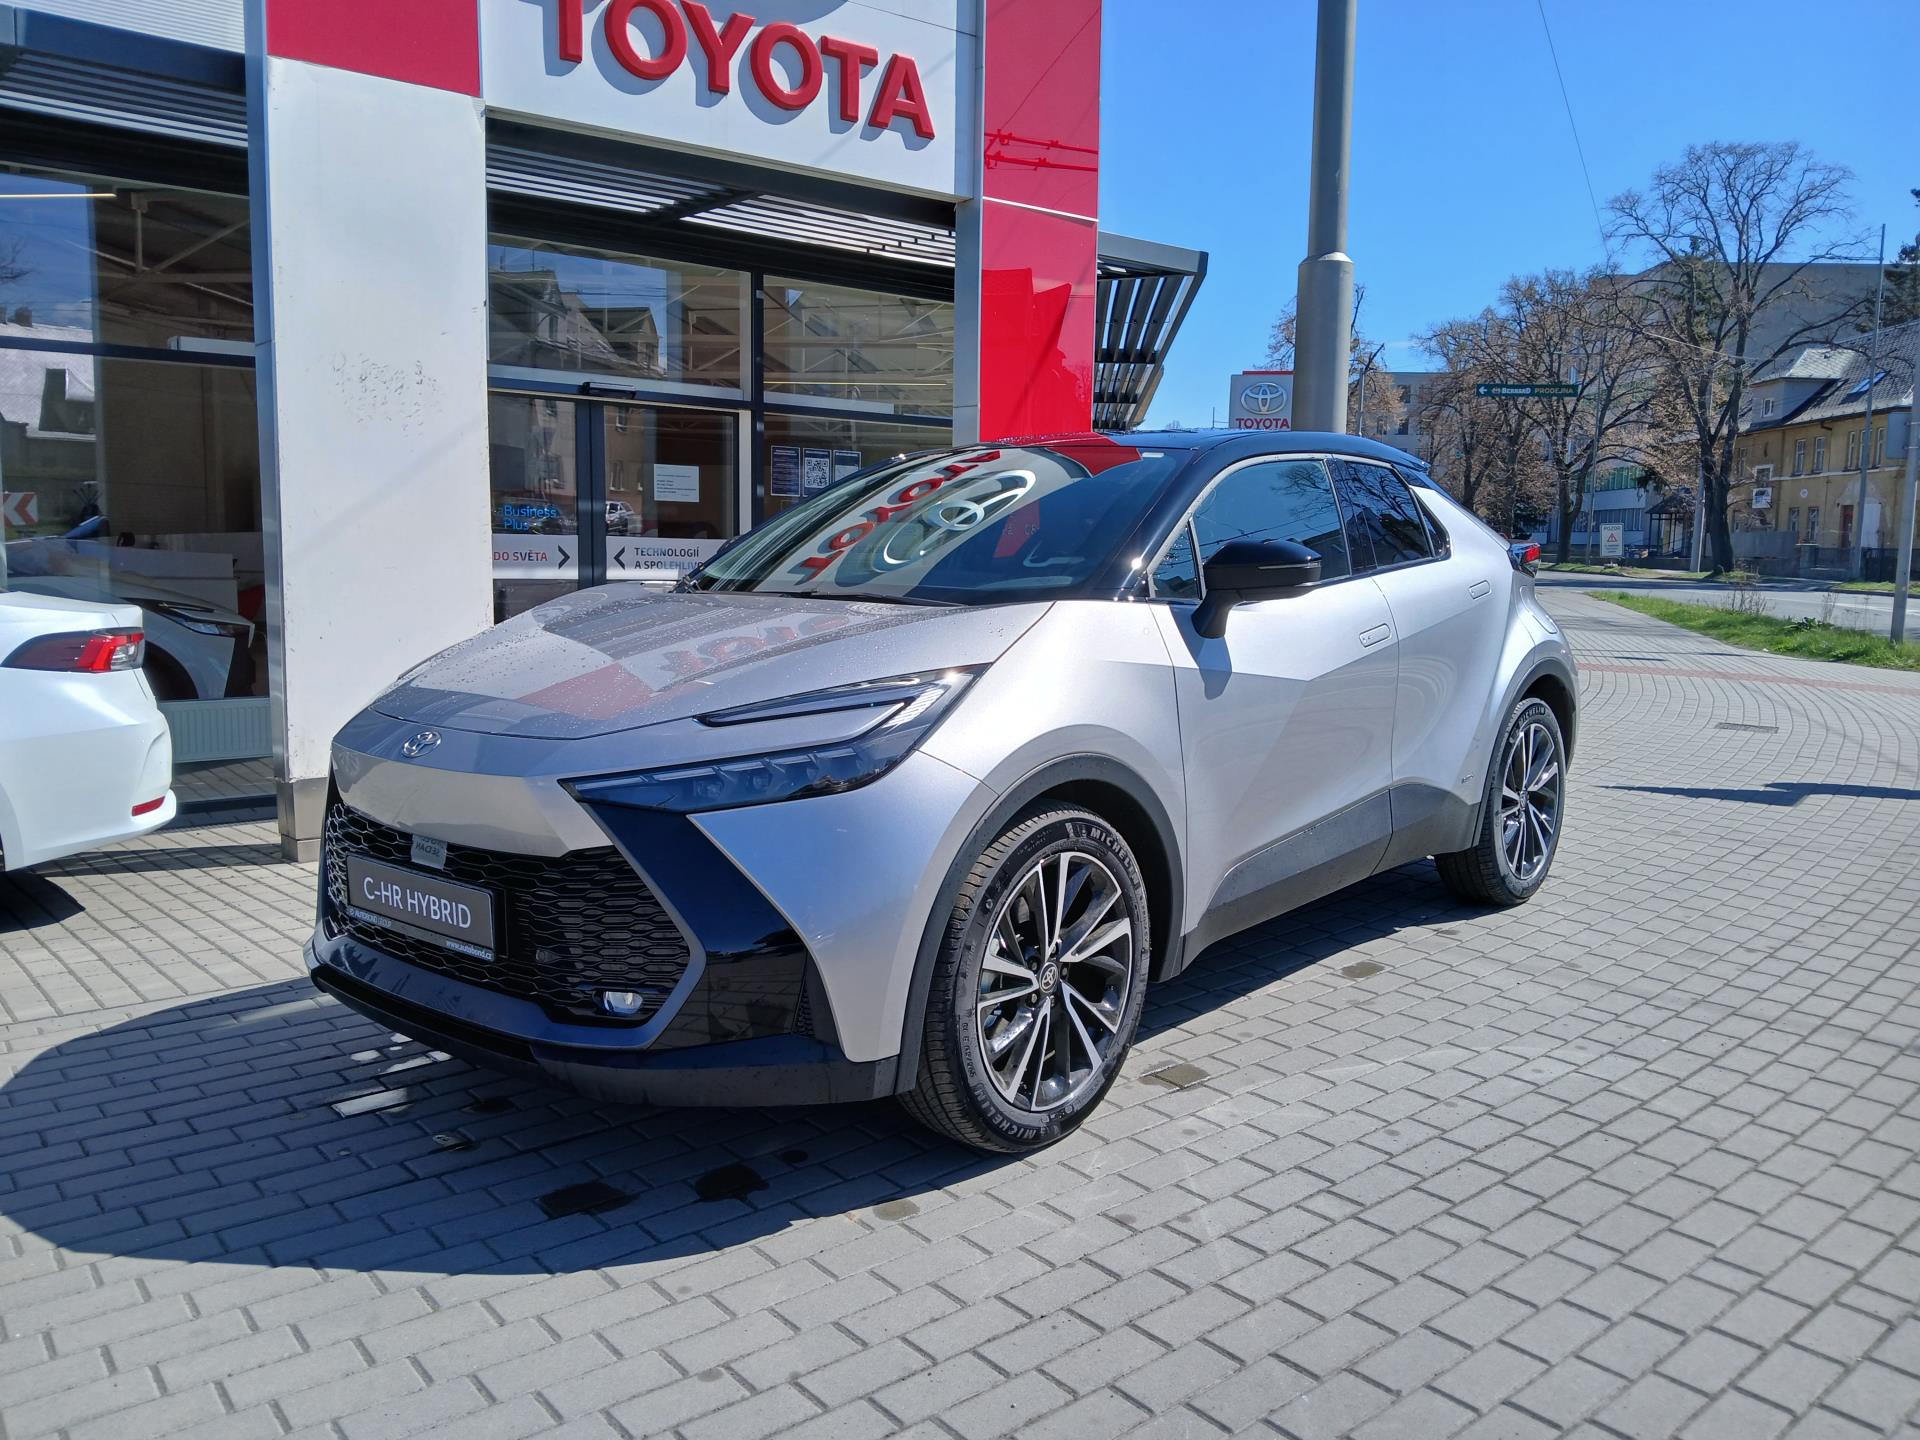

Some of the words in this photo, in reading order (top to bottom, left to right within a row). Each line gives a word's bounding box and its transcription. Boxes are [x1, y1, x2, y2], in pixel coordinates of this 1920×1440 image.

[1235, 418, 1290, 429] TOYOTA
[504, 504, 557, 518] Business
[504, 518, 530, 531] Plus
[493, 551, 509, 561] DO
[512, 549, 548, 561] SVĚTA
[634, 546, 699, 557] TECHNOLOGIÍ
[634, 560, 641, 569] A
[363, 877, 403, 909] C-HR
[406, 889, 471, 929] HYBRID
